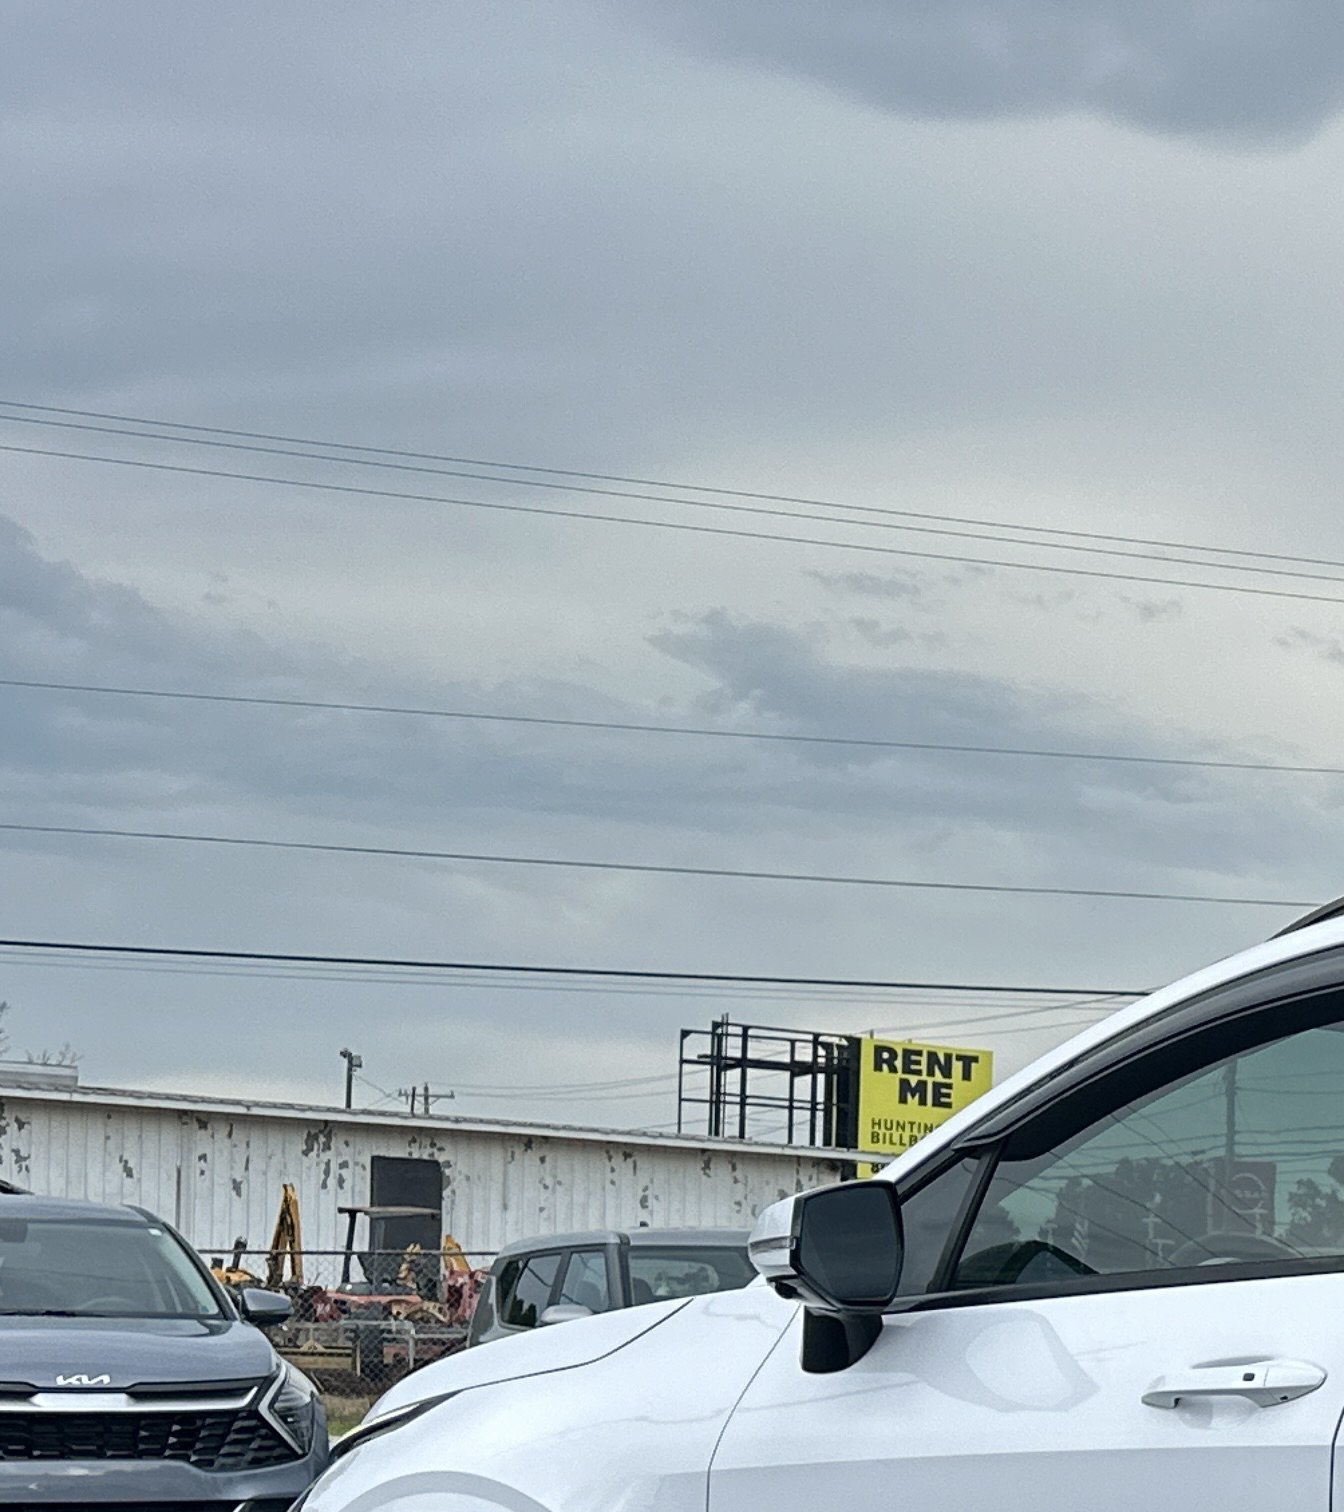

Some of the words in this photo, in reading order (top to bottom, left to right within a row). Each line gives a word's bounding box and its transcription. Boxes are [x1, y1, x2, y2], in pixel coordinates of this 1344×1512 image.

[874, 1045, 979, 1082] RENT
[898, 1078, 953, 1109] ME
[871, 1117, 940, 1135] HUNTIN
[870, 1131, 919, 1147] BILLB
[55, 1374, 110, 1386] KIA
